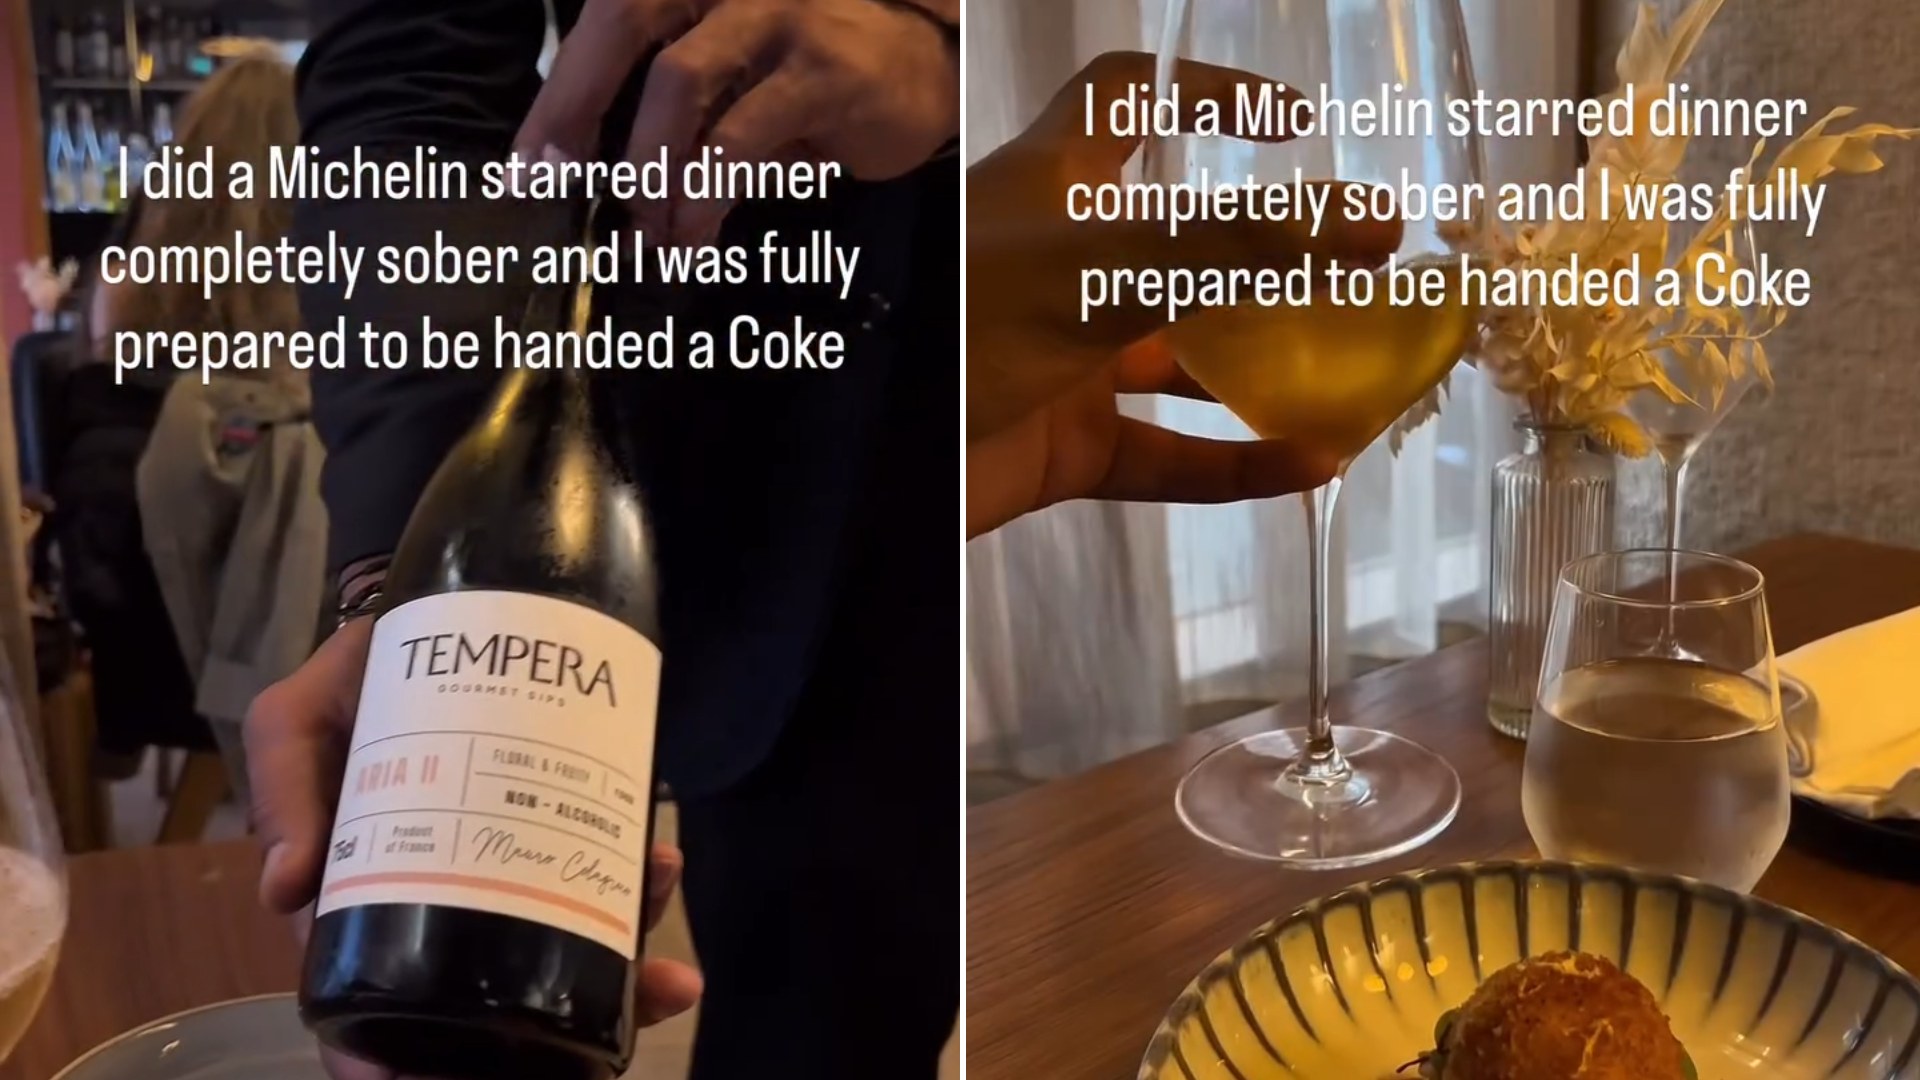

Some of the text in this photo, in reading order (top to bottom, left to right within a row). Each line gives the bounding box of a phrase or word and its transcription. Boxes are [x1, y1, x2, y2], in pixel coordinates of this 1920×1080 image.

[400, 632, 617, 708] TEMPERA
[437, 683, 566, 708] GOURMET SIPS
[493, 749, 535, 770] FLORAL
[504, 790, 538, 808] NON
[555, 802, 622, 839] ALCOHOLIC
[392, 825, 434, 837] Product
[385, 841, 436, 853] of France
